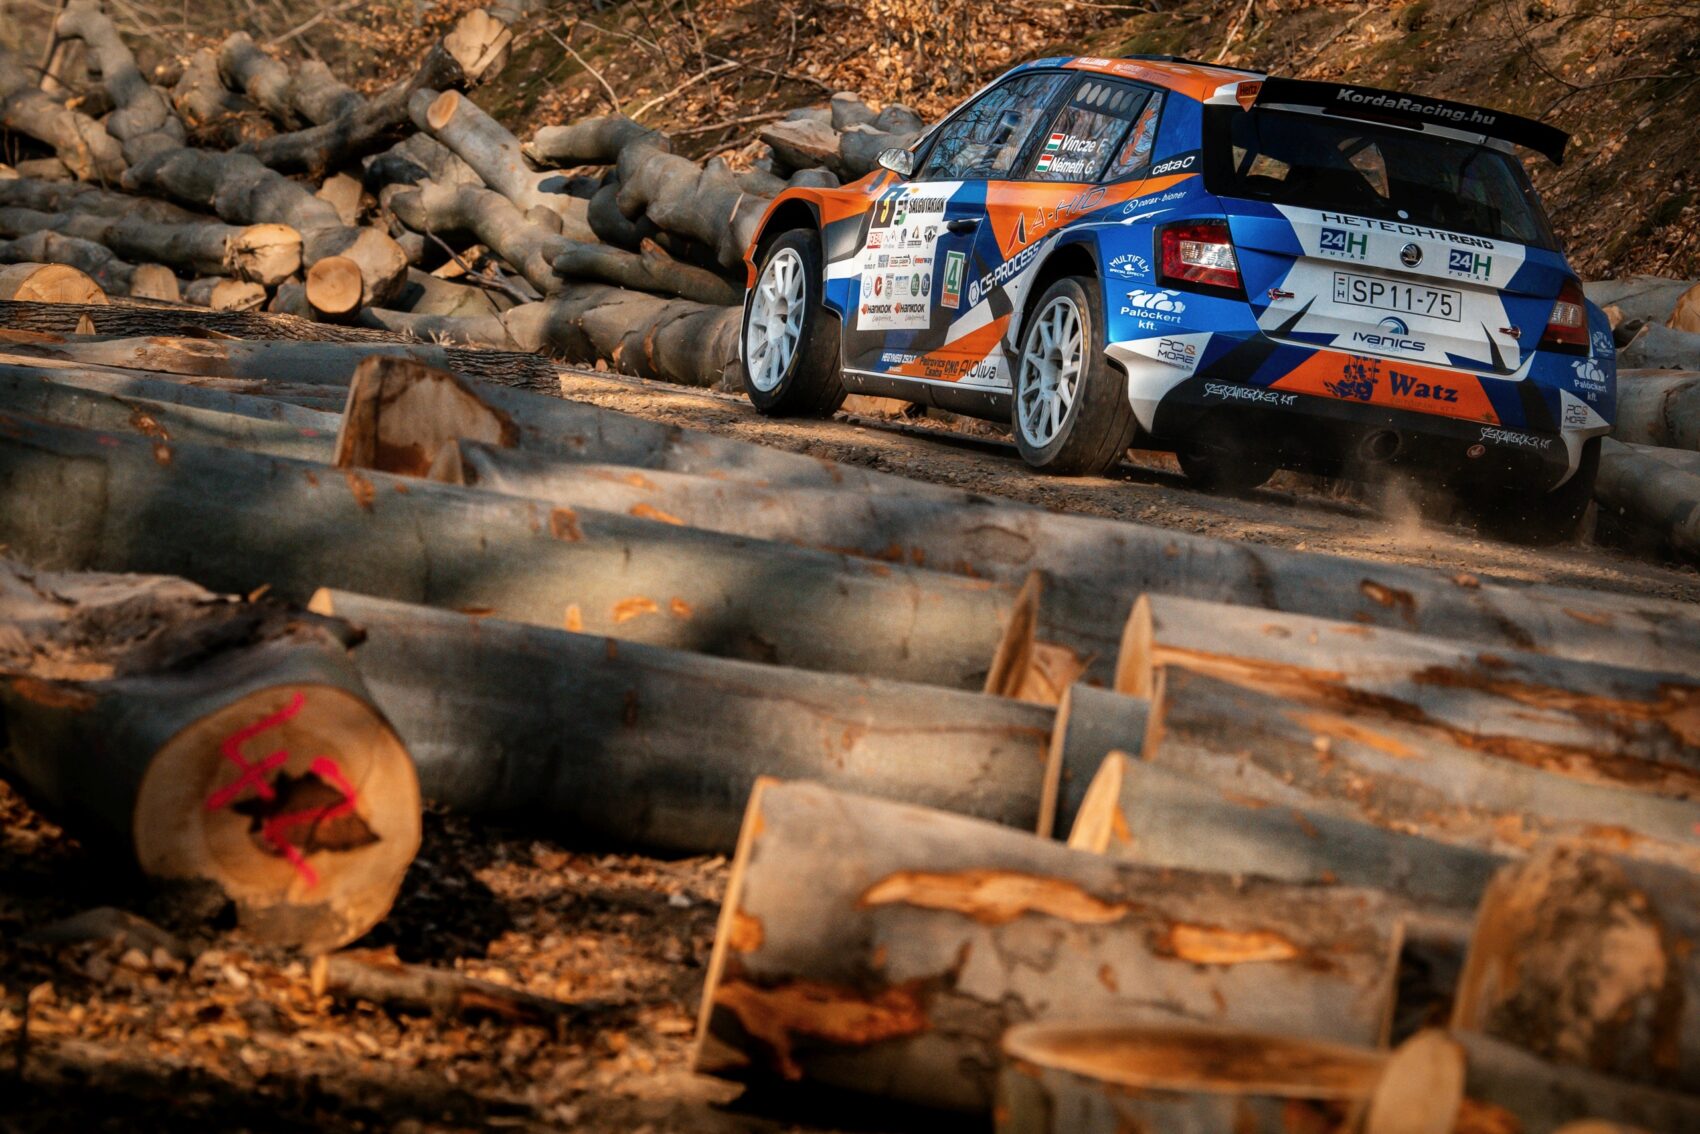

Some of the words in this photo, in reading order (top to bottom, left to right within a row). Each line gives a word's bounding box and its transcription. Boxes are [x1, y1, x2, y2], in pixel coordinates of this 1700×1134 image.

[1336, 88, 1497, 126] KordaRacing.hu
[1061, 135, 1096, 153] Vincze
[1049, 157, 1084, 174] Németh
[1084, 159, 1096, 174] G.
[1320, 227, 1368, 256] 24H
[979, 241, 1042, 297] CS-PROCESS
[1109, 253, 1151, 273] MULTIFILM
[1449, 248, 1493, 276] 24H
[947, 258, 959, 292] 4
[1337, 290, 1345, 299] H
[1352, 279, 1453, 317] SP11-75
[1120, 306, 1182, 323] Palóckert
[1138, 319, 1158, 331] kft.
[1157, 349, 1195, 365] MORE
[1159, 337, 1196, 356] PC&
[1388, 370, 1459, 404] Watz
